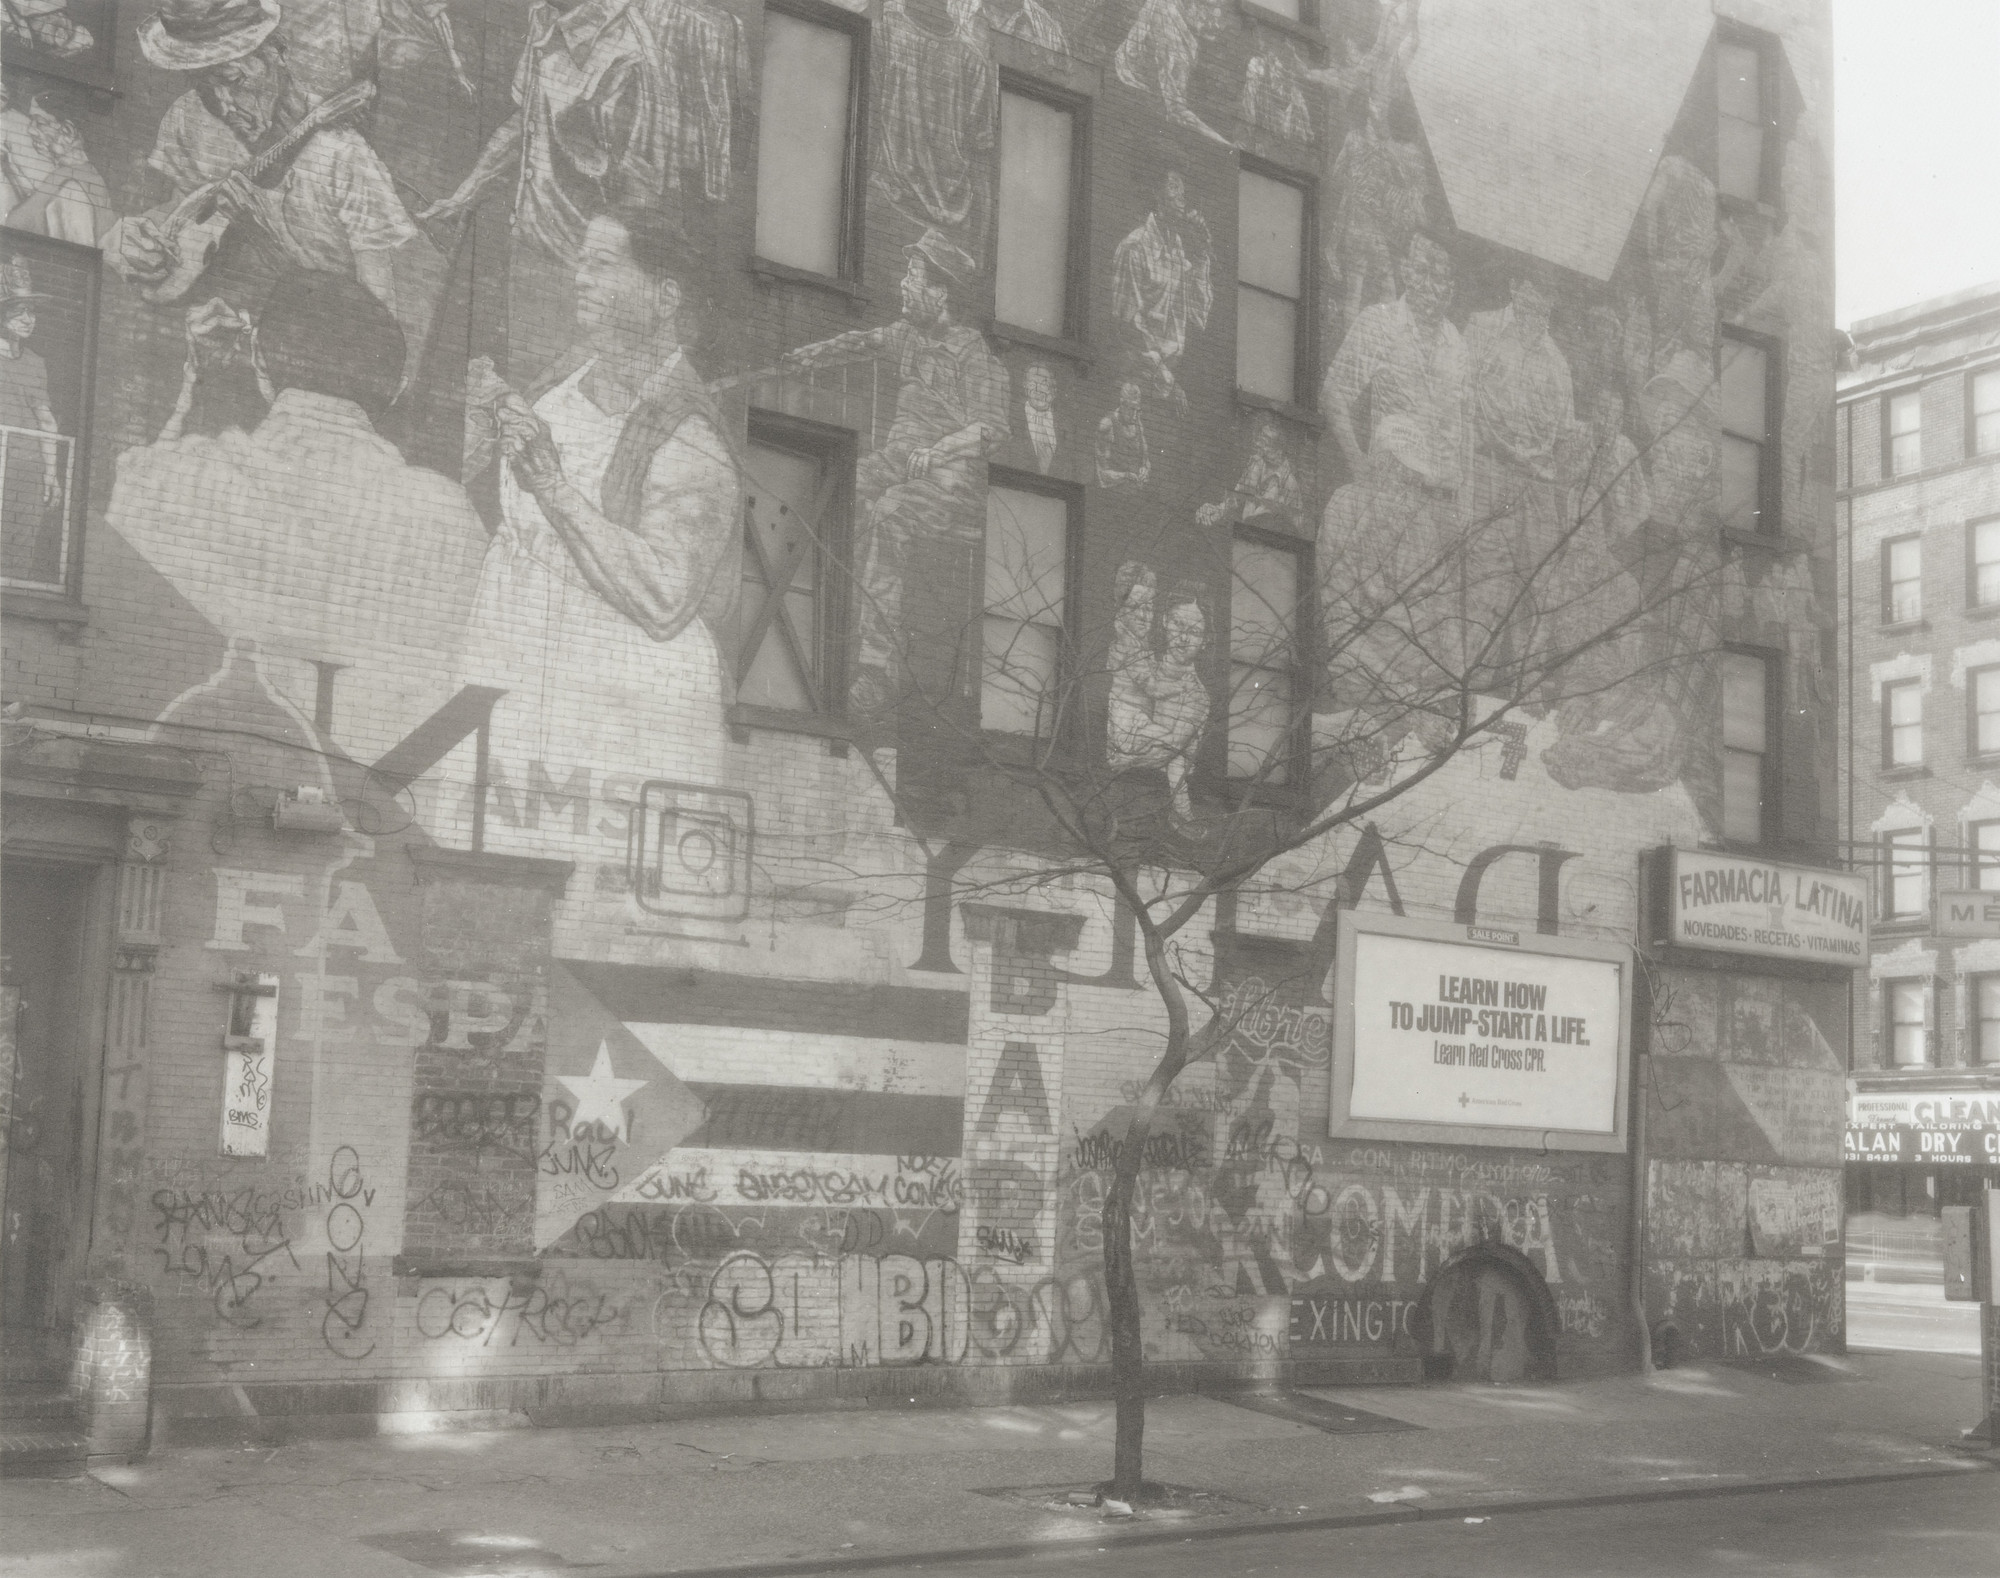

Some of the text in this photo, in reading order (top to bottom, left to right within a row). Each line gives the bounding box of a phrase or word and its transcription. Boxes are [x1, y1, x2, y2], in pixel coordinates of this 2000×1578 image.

[1678, 867, 1864, 934] FARMACIA LATINA
[1471, 929, 1516, 945] SALE POINT
[1683, 918, 1861, 957] NOVEDADES RECETAS VITAMINAS
[1438, 974, 1547, 1012] LEARN HOW
[1388, 1000, 1591, 1047] TO JUMP-START A LIFE.
[1433, 1039, 1547, 1073] Learn Red Cross CPR.
[1857, 1101, 1910, 1112] PROFESSIONAL
[1909, 1123, 1983, 1131] TAILORING
[1845, 1131, 1900, 1152] ALAN
[1920, 1132, 1962, 1153] DRY
[1411, 1149, 1468, 1170] RITMO
[1866, 1153, 1898, 1162] 8489
[1914, 1154, 1923, 1162] 3
[1931, 1154, 1972, 1163] HOURS
[1076, 1212, 1158, 1256] SM
